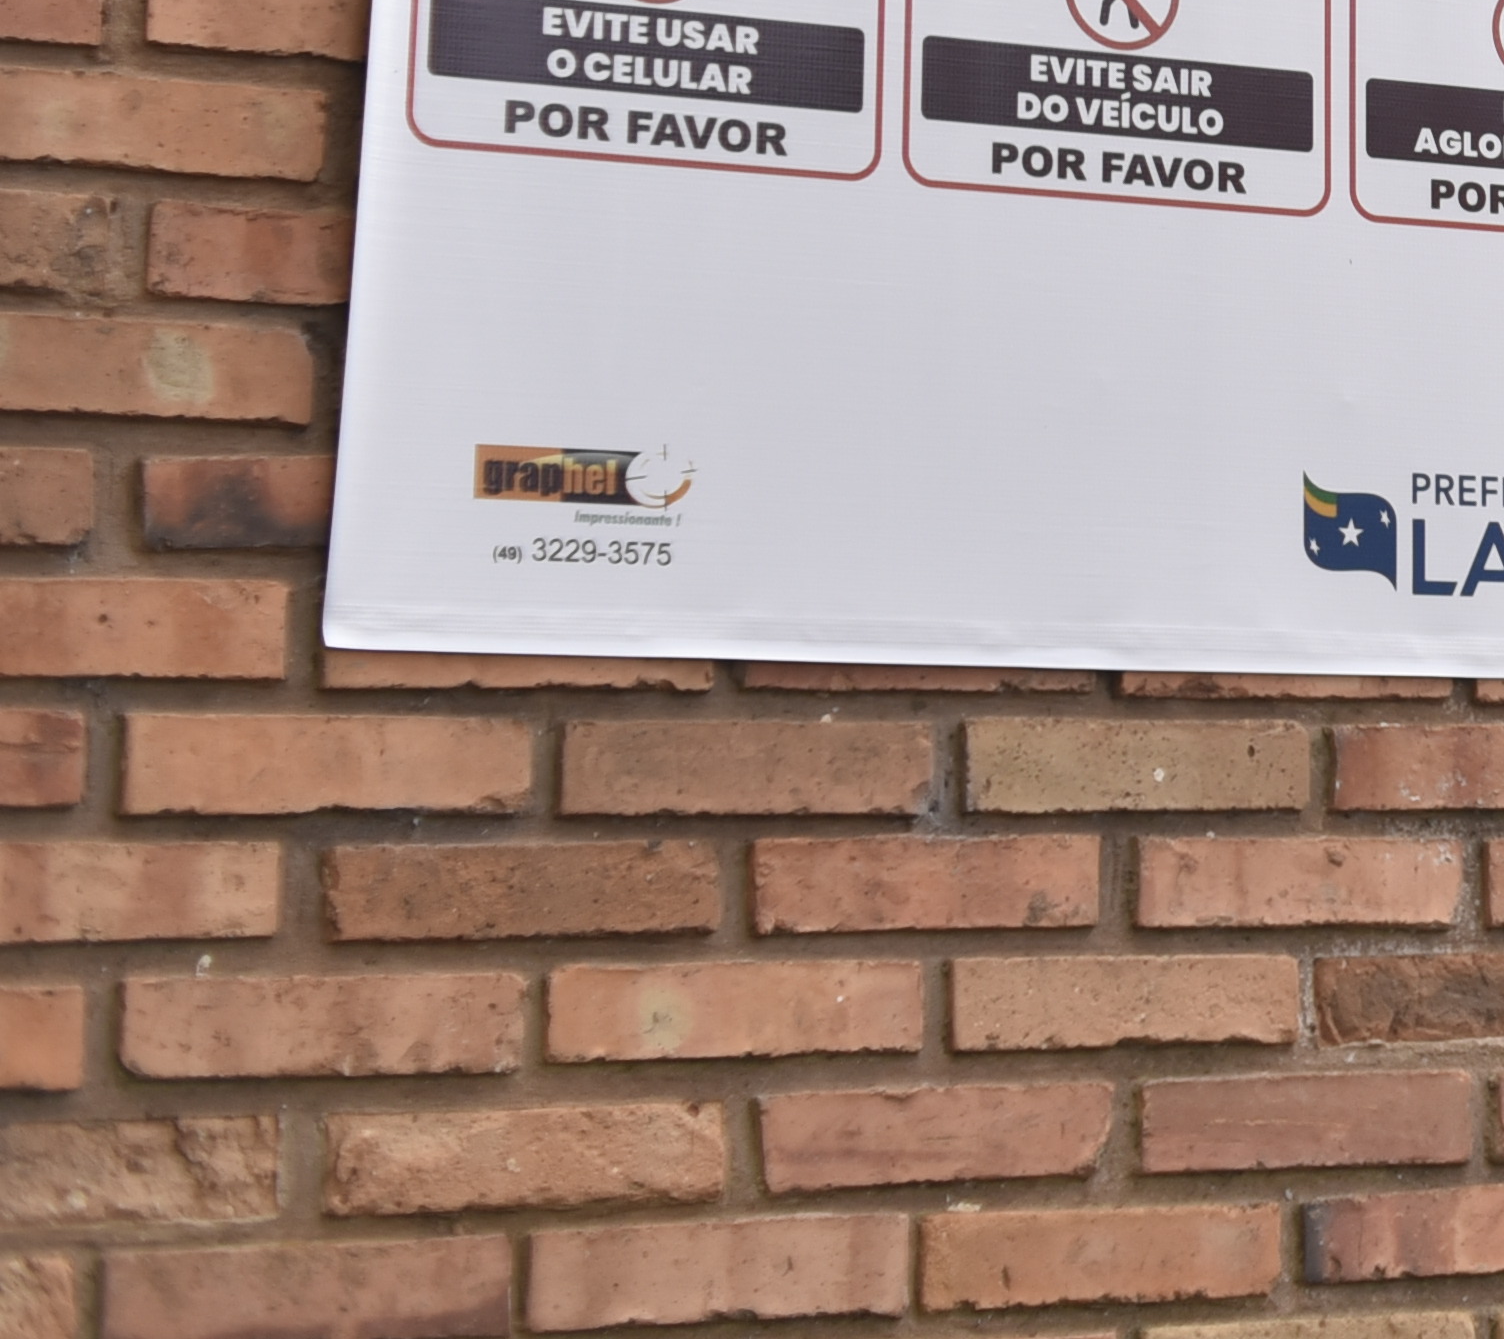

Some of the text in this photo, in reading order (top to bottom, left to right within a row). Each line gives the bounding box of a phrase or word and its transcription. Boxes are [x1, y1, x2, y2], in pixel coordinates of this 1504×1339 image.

[542, 7, 759, 55] EVITE USAR
[547, 49, 752, 94] O CELULAR
[1029, 54, 1212, 97] EVITE SAIR
[504, 100, 787, 156] POR FAVOR
[1016, 93, 1224, 135] DO VEÍCULO
[991, 141, 1247, 194] POR FAVOR
[483, 457, 619, 496] graphel
[574, 510, 673, 527] Impressionante
[493, 537, 672, 566] (49) 3229-3575
